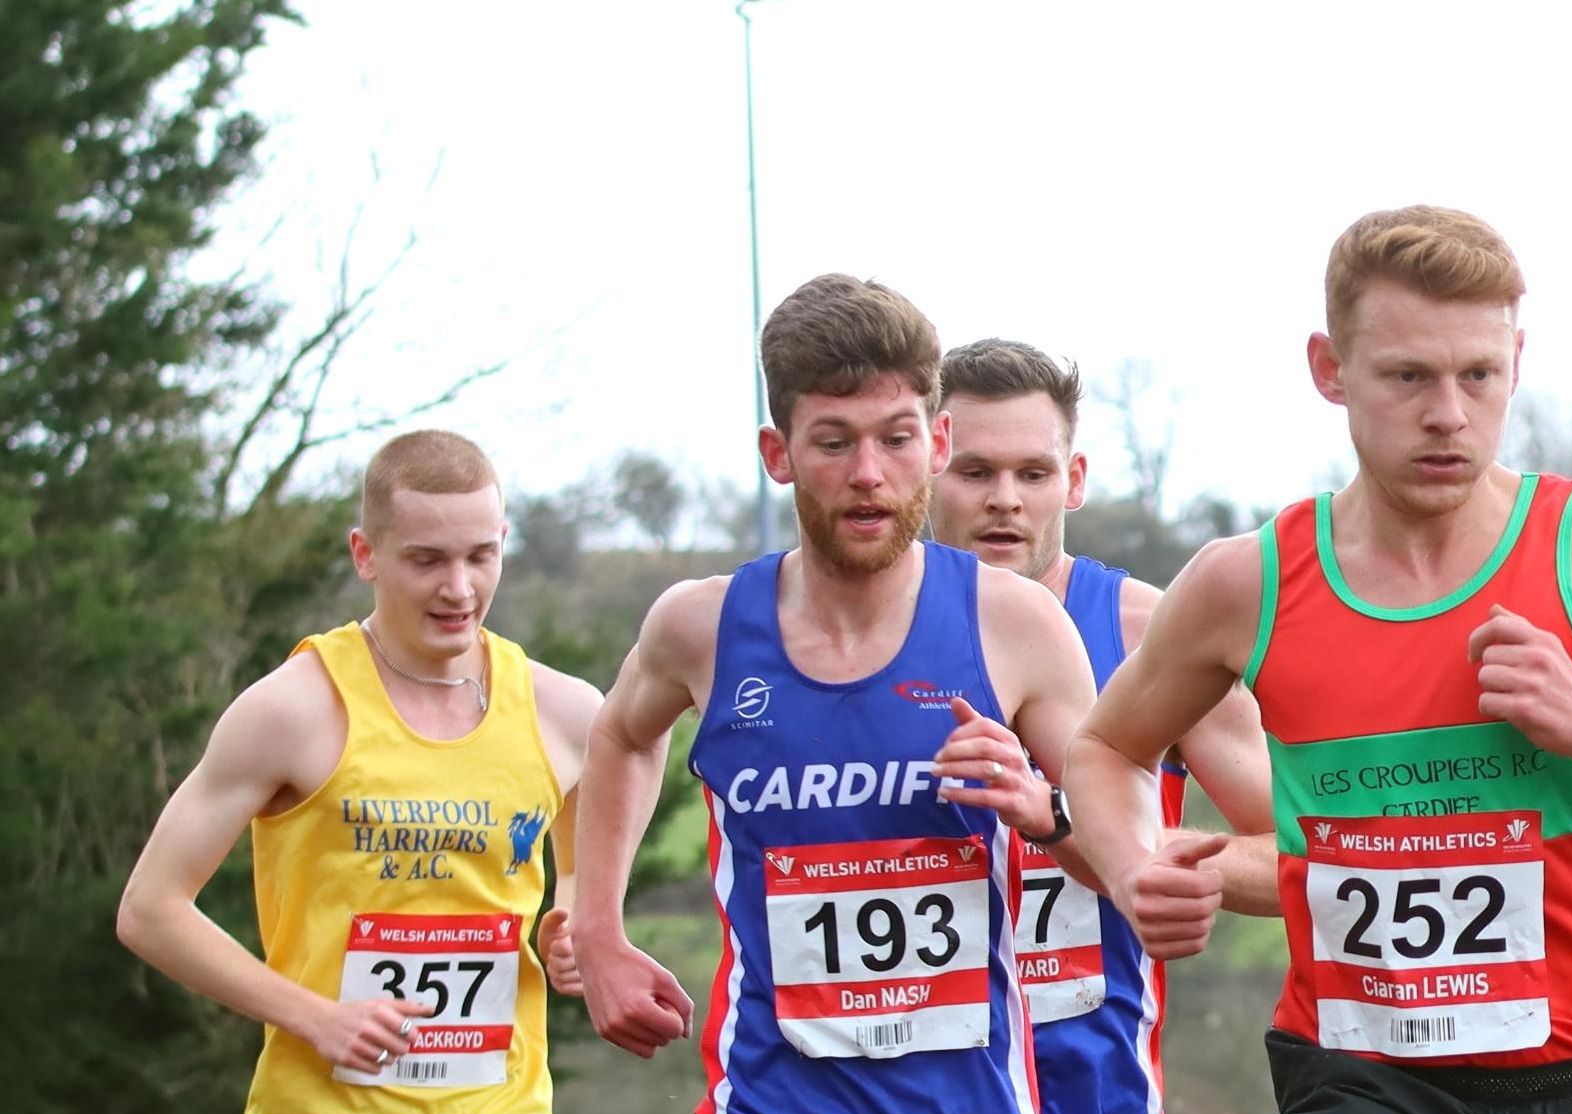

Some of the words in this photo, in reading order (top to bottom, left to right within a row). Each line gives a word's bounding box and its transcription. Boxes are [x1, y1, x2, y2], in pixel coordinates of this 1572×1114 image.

[1311, 770, 1350, 797] LES
[1359, 756, 1501, 788] CROUPIERS
[342, 798, 498, 827] LIVERPOOL
[353, 827, 489, 855] HARRIERS
[1340, 833, 1395, 851] WELSH
[1400, 831, 1497, 852] ATHLETICS
[379, 856, 399, 880] &
[406, 855, 454, 880] A.C.
[804, 861, 860, 878] WELSH
[864, 854, 949, 873] ATHLETICS
[1336, 875, 1508, 960] 252
[379, 928, 426, 943] WELSH
[427, 928, 494, 943] ATHLETICS
[804, 892, 961, 974] 193
[369, 960, 495, 1019] 357
[841, 989, 878, 1010] Dan
[881, 983, 931, 1008] NASH
[1362, 975, 1418, 1000] Ciaran
[1422, 972, 1489, 999] LEWIS
[413, 1030, 483, 1049] ACKROYD
